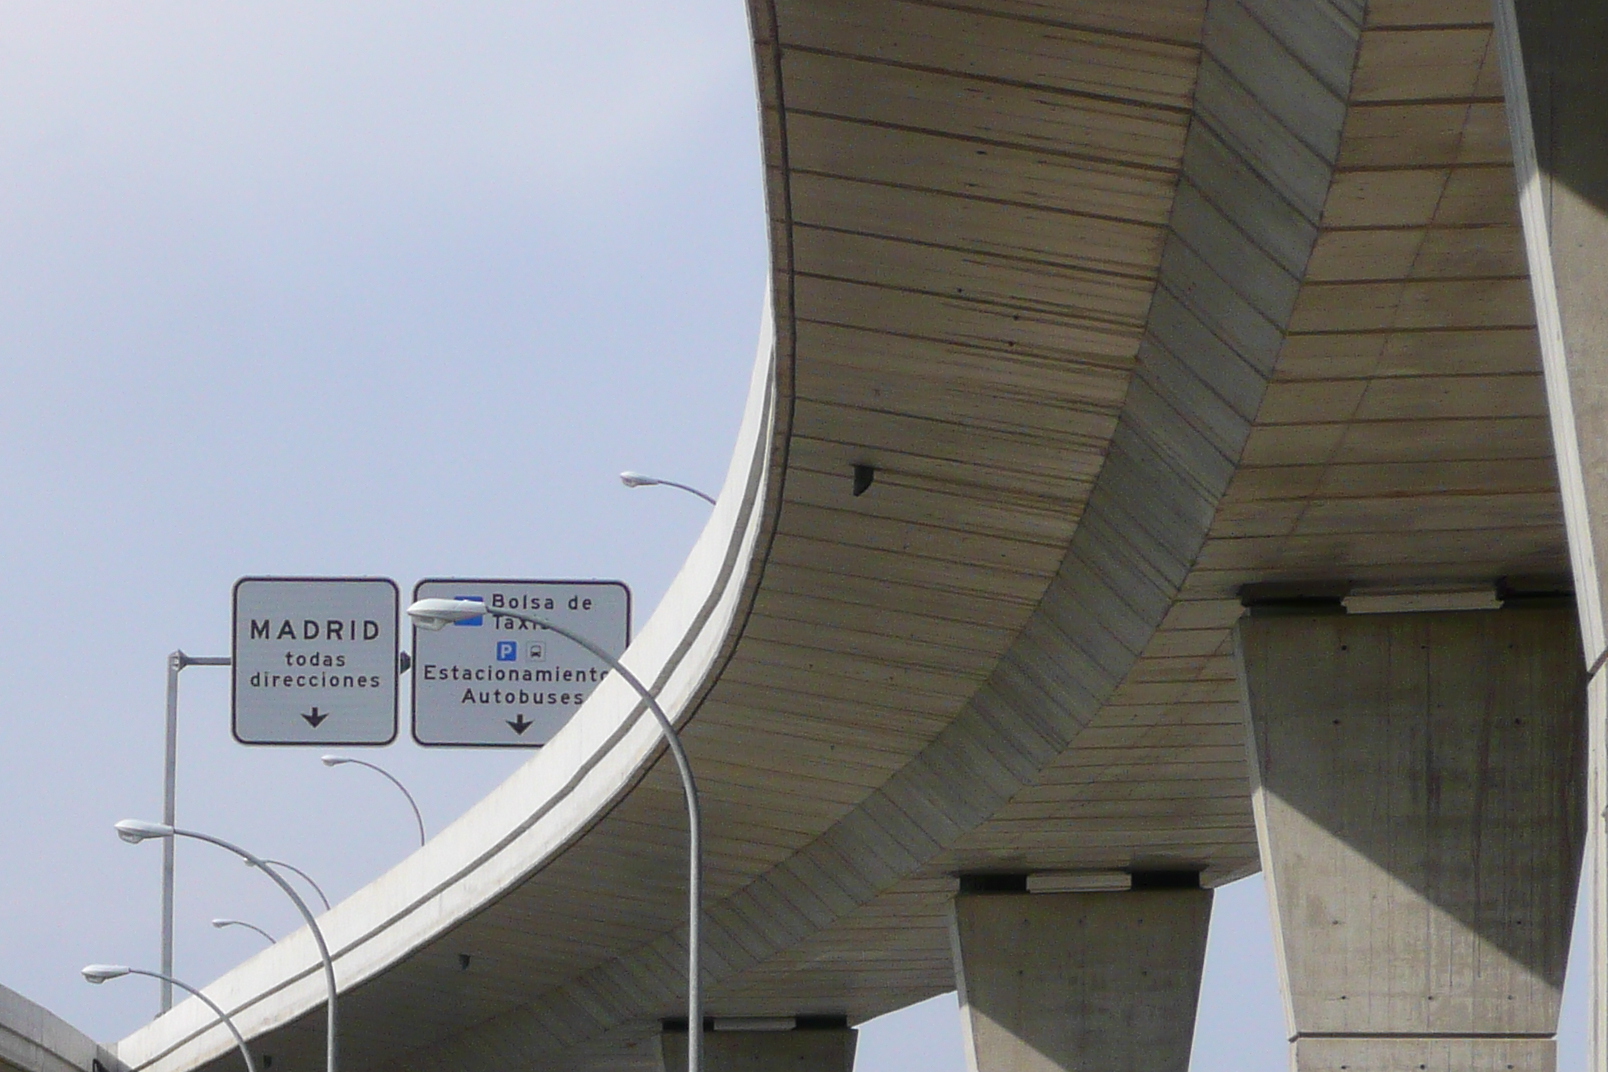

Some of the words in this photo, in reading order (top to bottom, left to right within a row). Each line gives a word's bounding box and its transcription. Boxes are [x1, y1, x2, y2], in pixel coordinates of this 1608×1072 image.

[492, 594, 555, 610] Bolsa
[568, 595, 592, 610] de
[250, 619, 380, 640] MADRID
[285, 651, 346, 667] todas
[250, 671, 380, 688] direcciones
[462, 688, 584, 704] Autobuses
